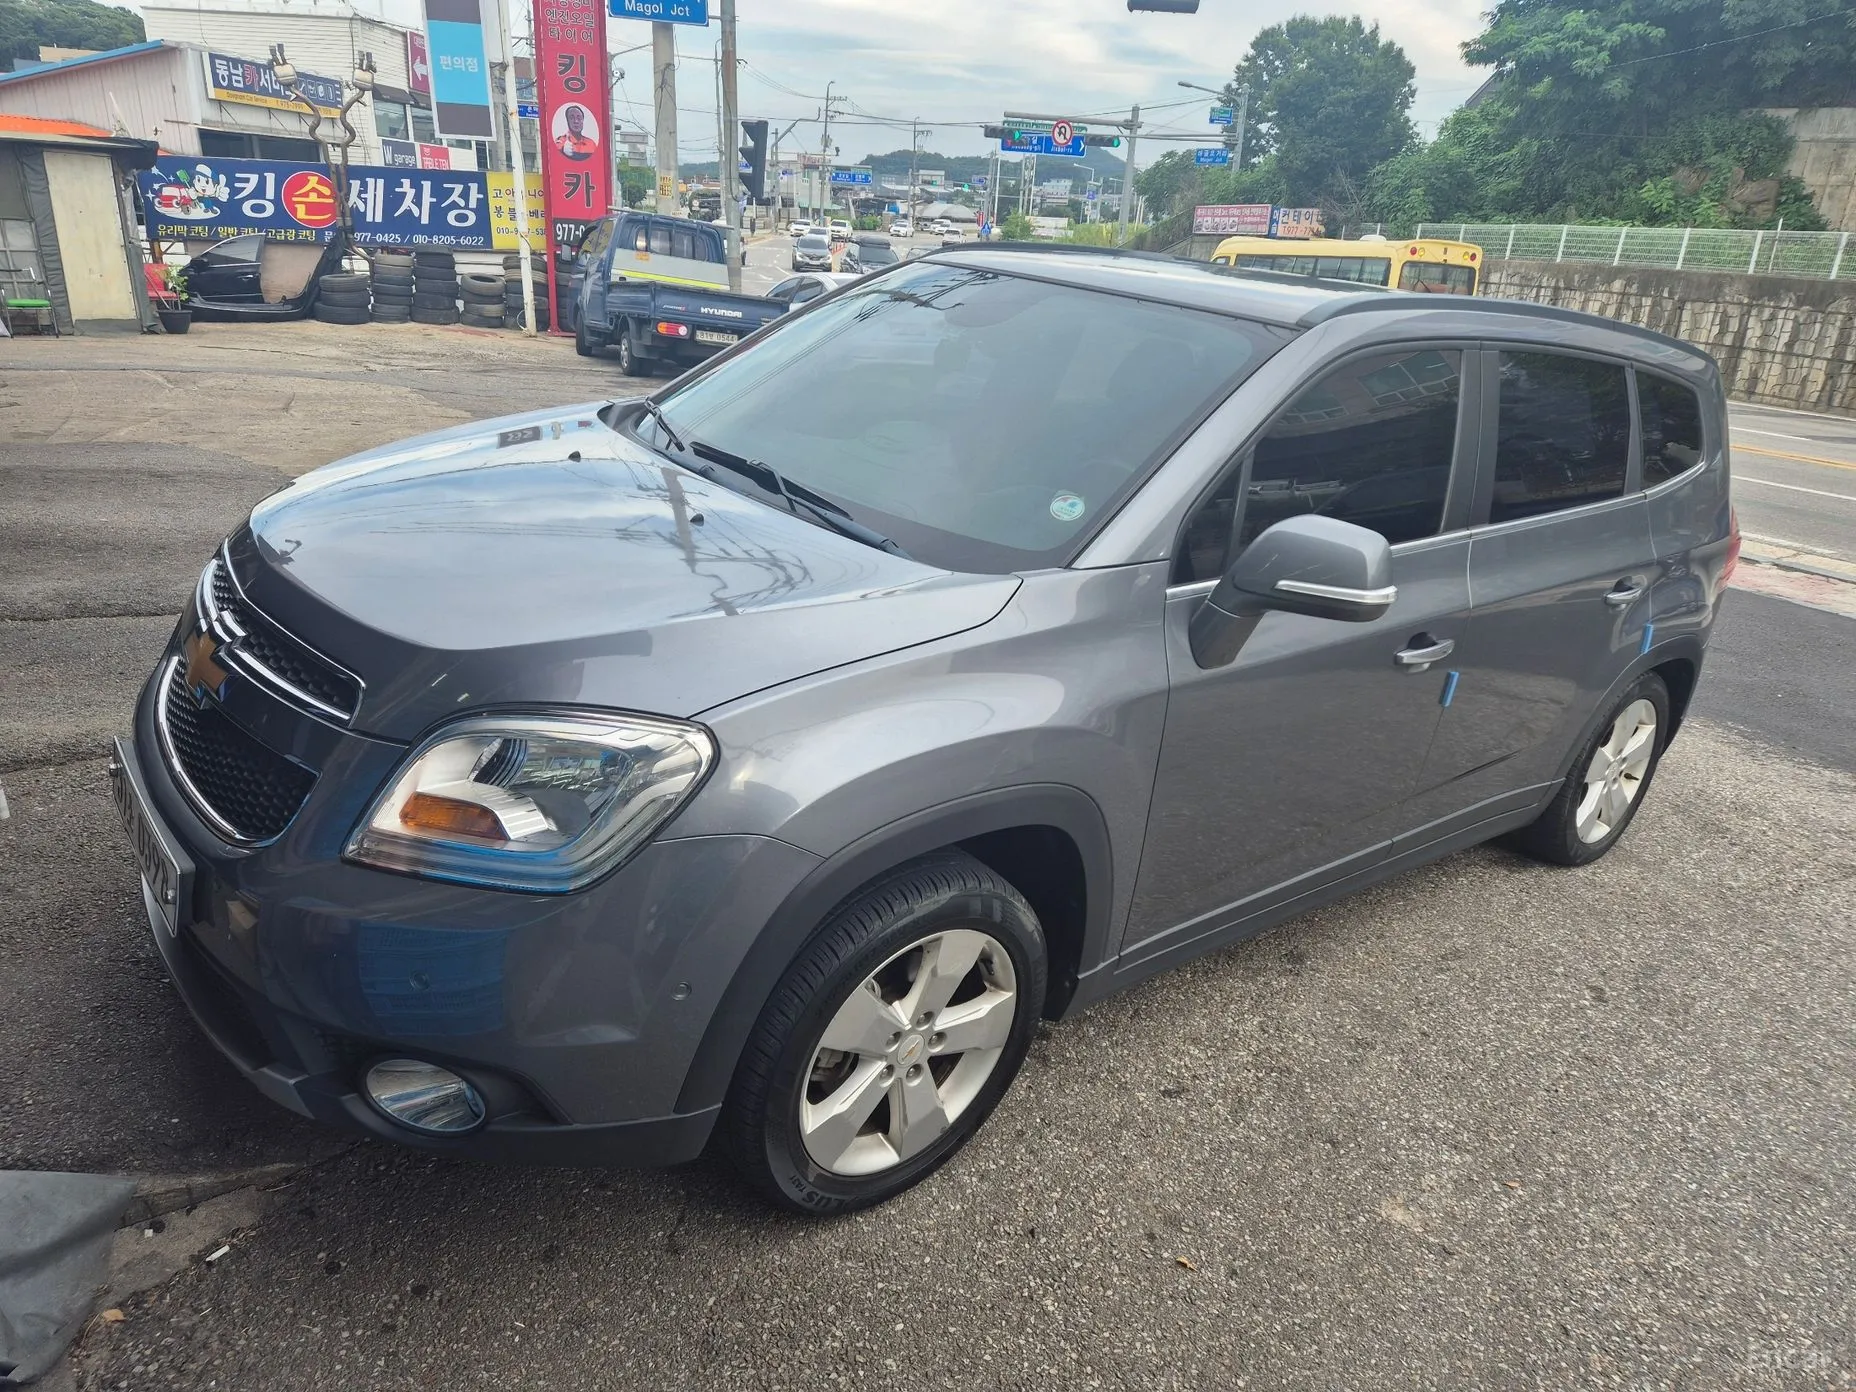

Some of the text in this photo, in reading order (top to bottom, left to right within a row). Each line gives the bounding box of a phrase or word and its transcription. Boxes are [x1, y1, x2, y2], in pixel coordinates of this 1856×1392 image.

[545, 8, 595, 27] 엔진오일
[624, 0, 690, 16] Magol Jct
[549, 27, 594, 45] 타이어
[439, 55, 479, 72] 편의점
[556, 53, 587, 93] 킹
[383, 145, 416, 167] W garage
[563, 171, 597, 208] 카
[157, 224, 189, 237] 유리막
[190, 225, 209, 237] 코팅
[218, 225, 237, 238] 일반
[267, 228, 296, 241] 고급광
[297, 229, 316, 242] 코팅
[412, 235, 484, 246] 010-8205-6022
[700, 306, 742, 318] HYUNDAI
